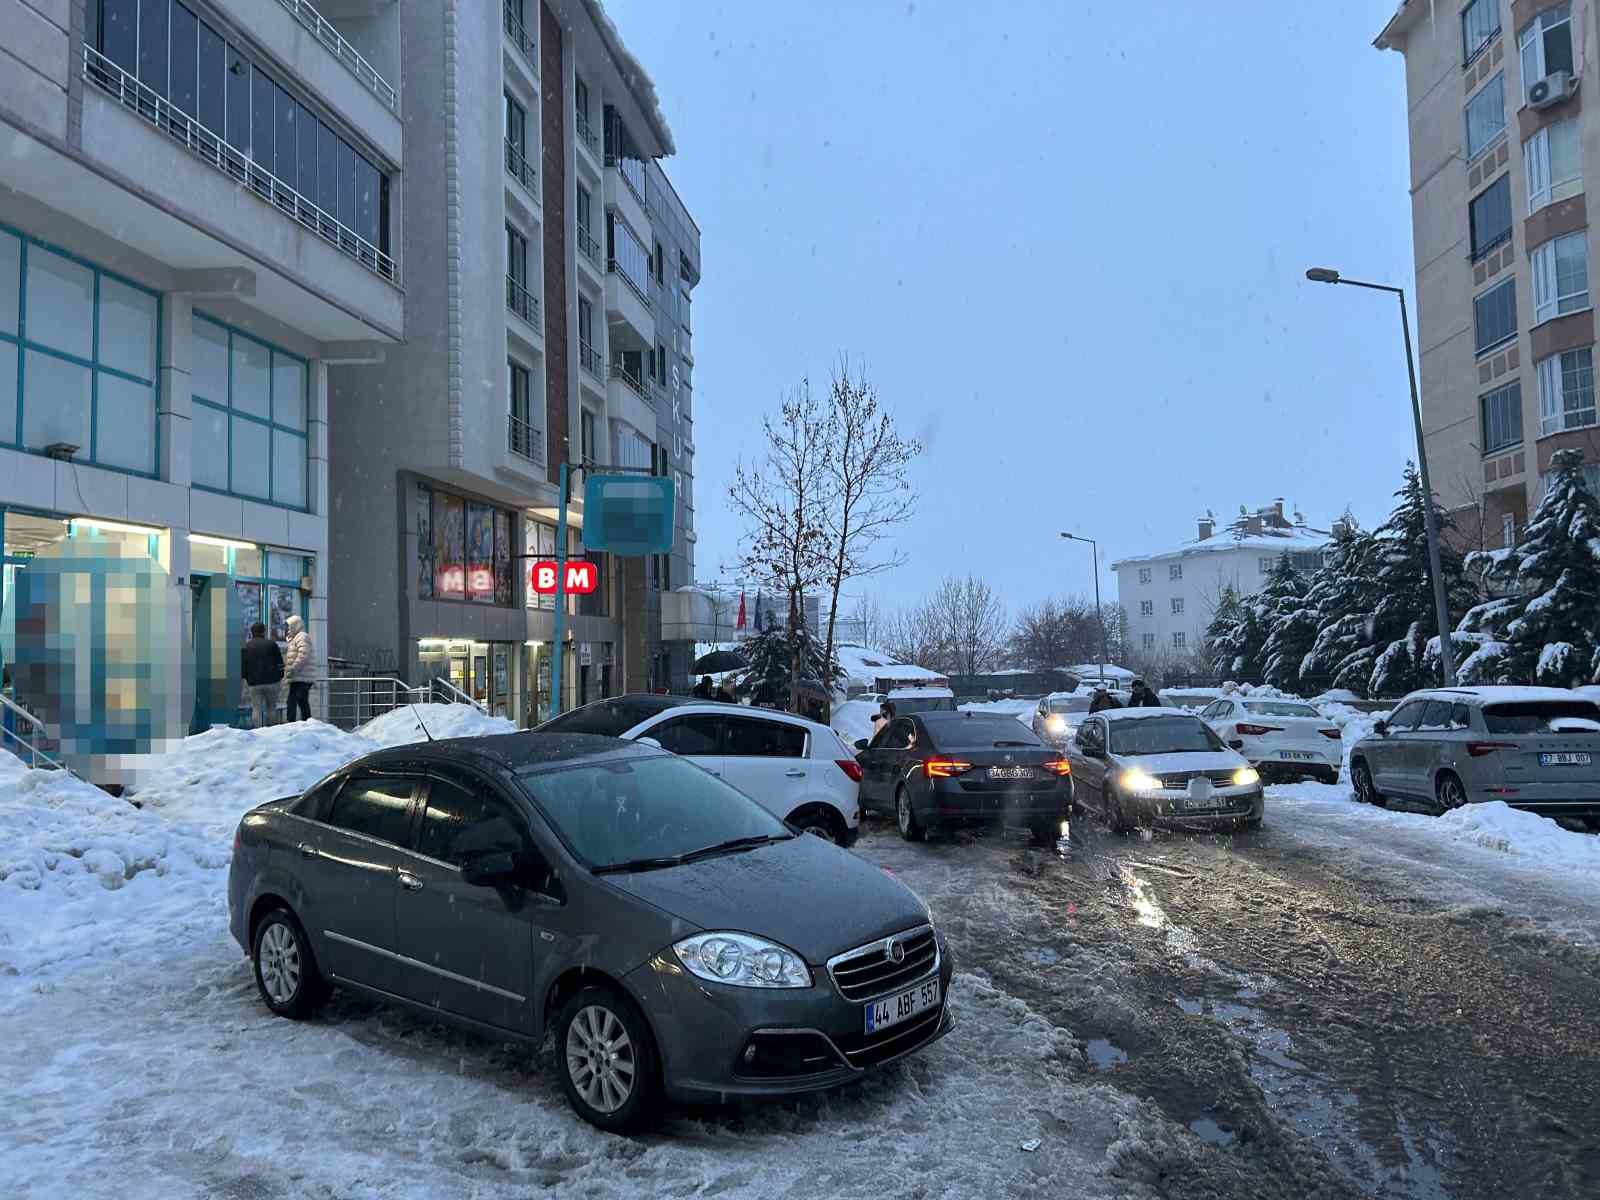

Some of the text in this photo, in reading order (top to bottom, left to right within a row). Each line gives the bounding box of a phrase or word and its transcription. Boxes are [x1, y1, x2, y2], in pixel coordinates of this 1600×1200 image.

[538, 567, 590, 589] BM
[875, 980, 938, 1025] 44 ABF 557
